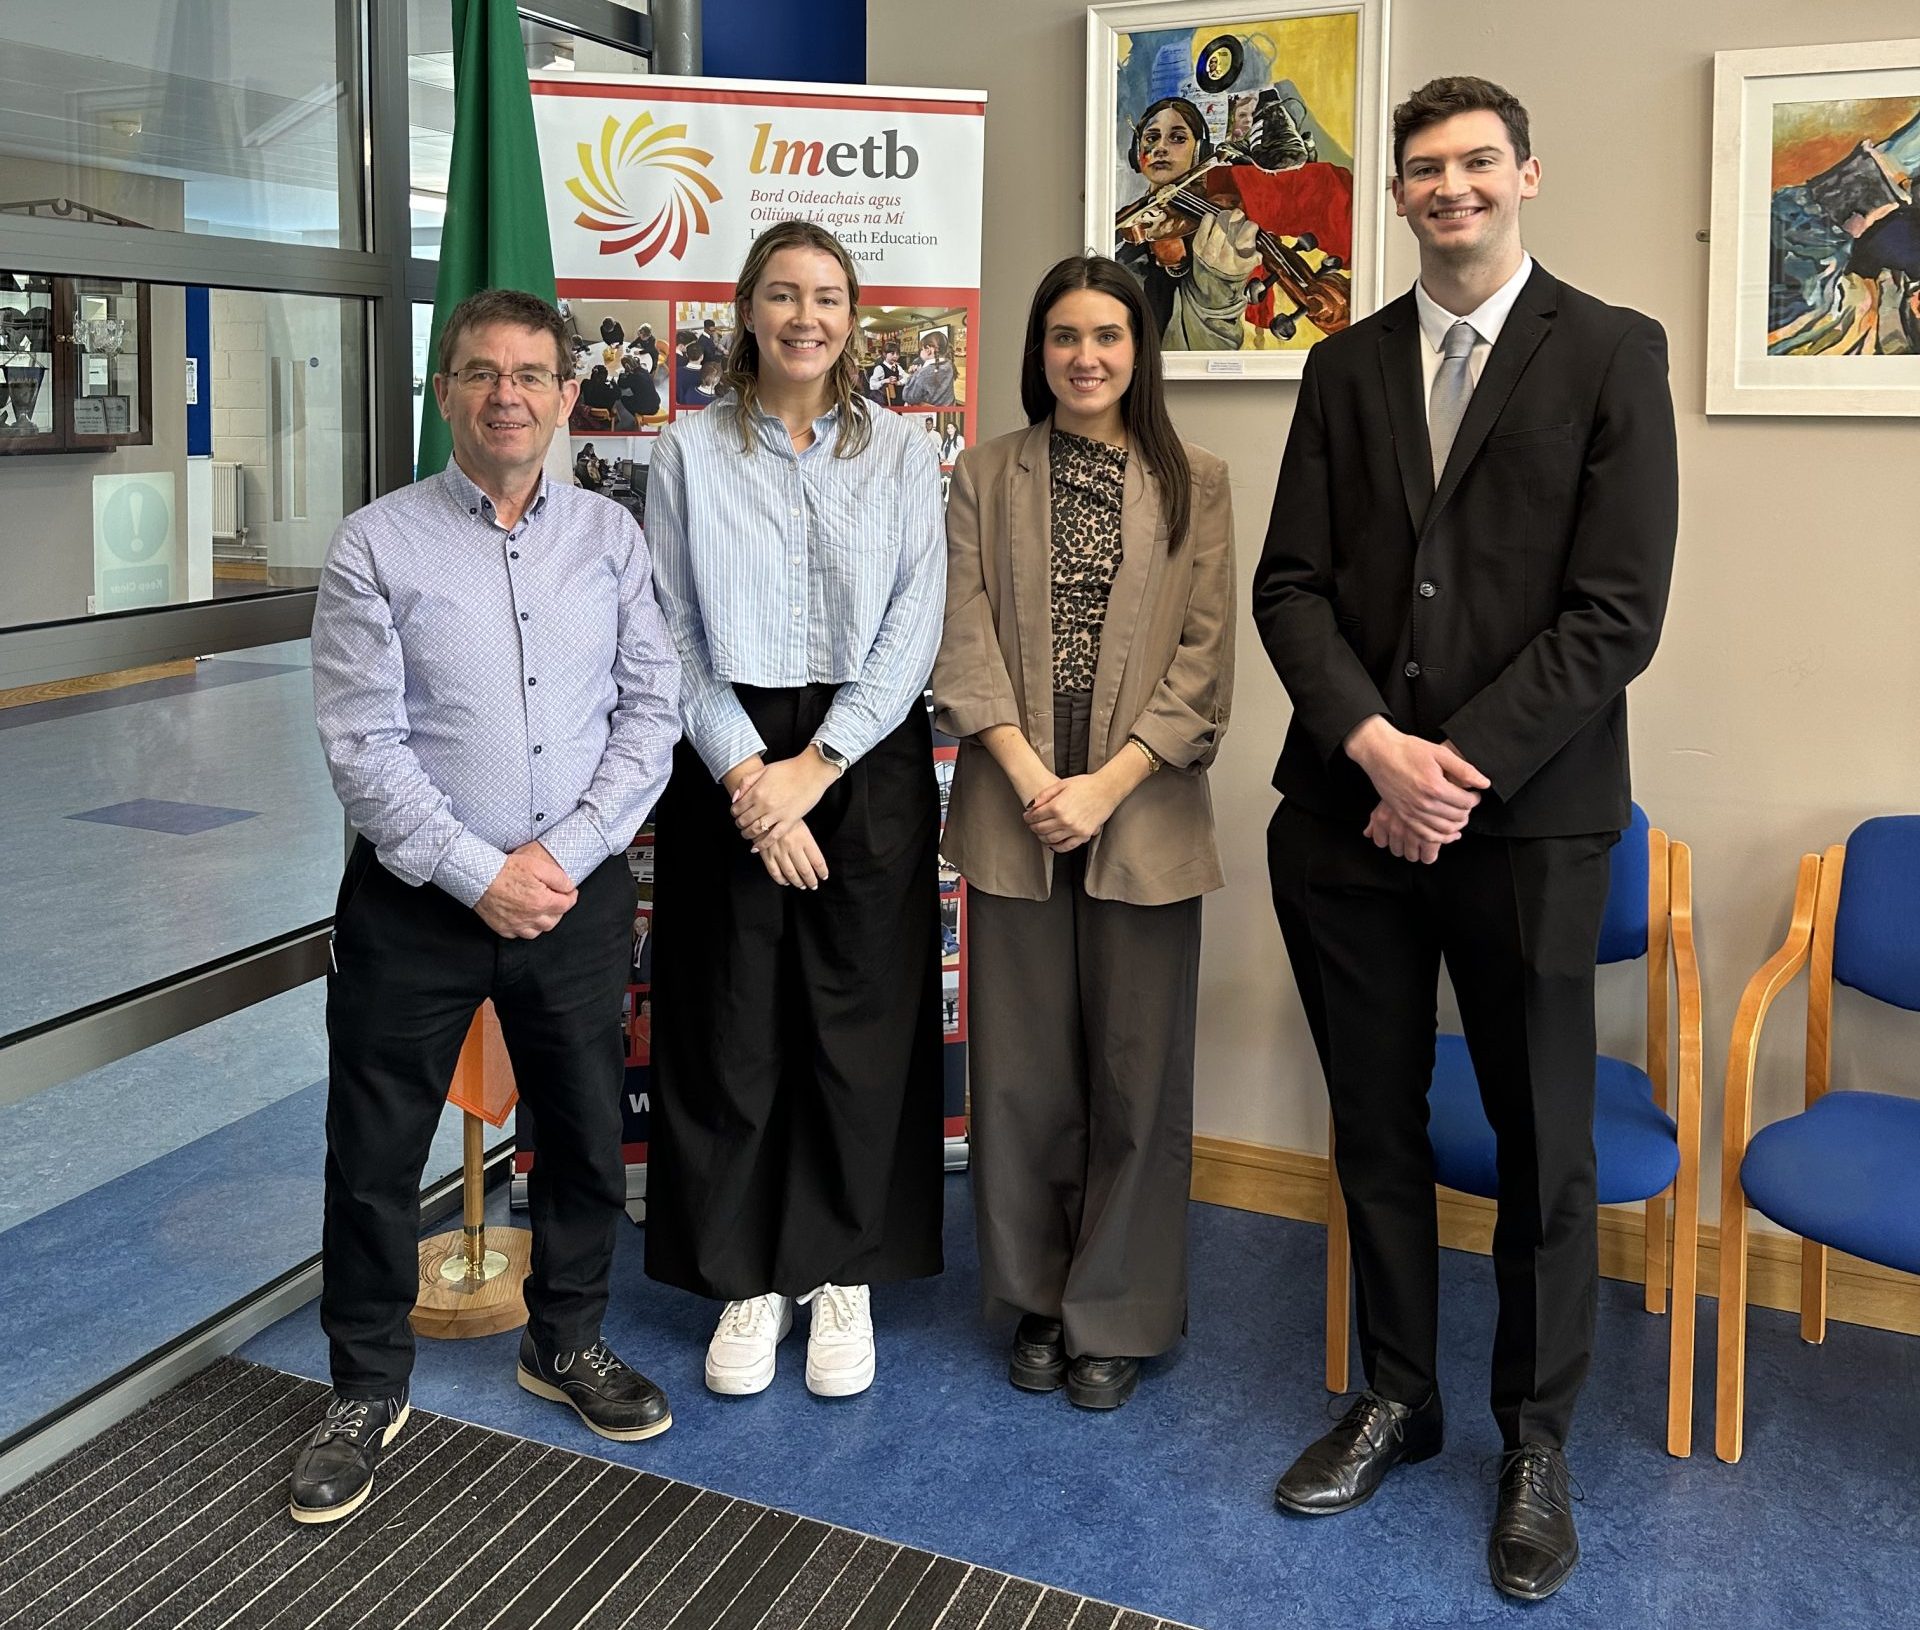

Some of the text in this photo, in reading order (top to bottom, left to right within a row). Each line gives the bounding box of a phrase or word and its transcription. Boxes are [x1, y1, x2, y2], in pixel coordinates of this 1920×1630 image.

[748, 122, 919, 180] lmetb
[750, 189, 901, 209] Bord Oideachais agus
[750, 207, 905, 227] Oiliúna Lú agus na Mí
[871, 230, 938, 246] Education
